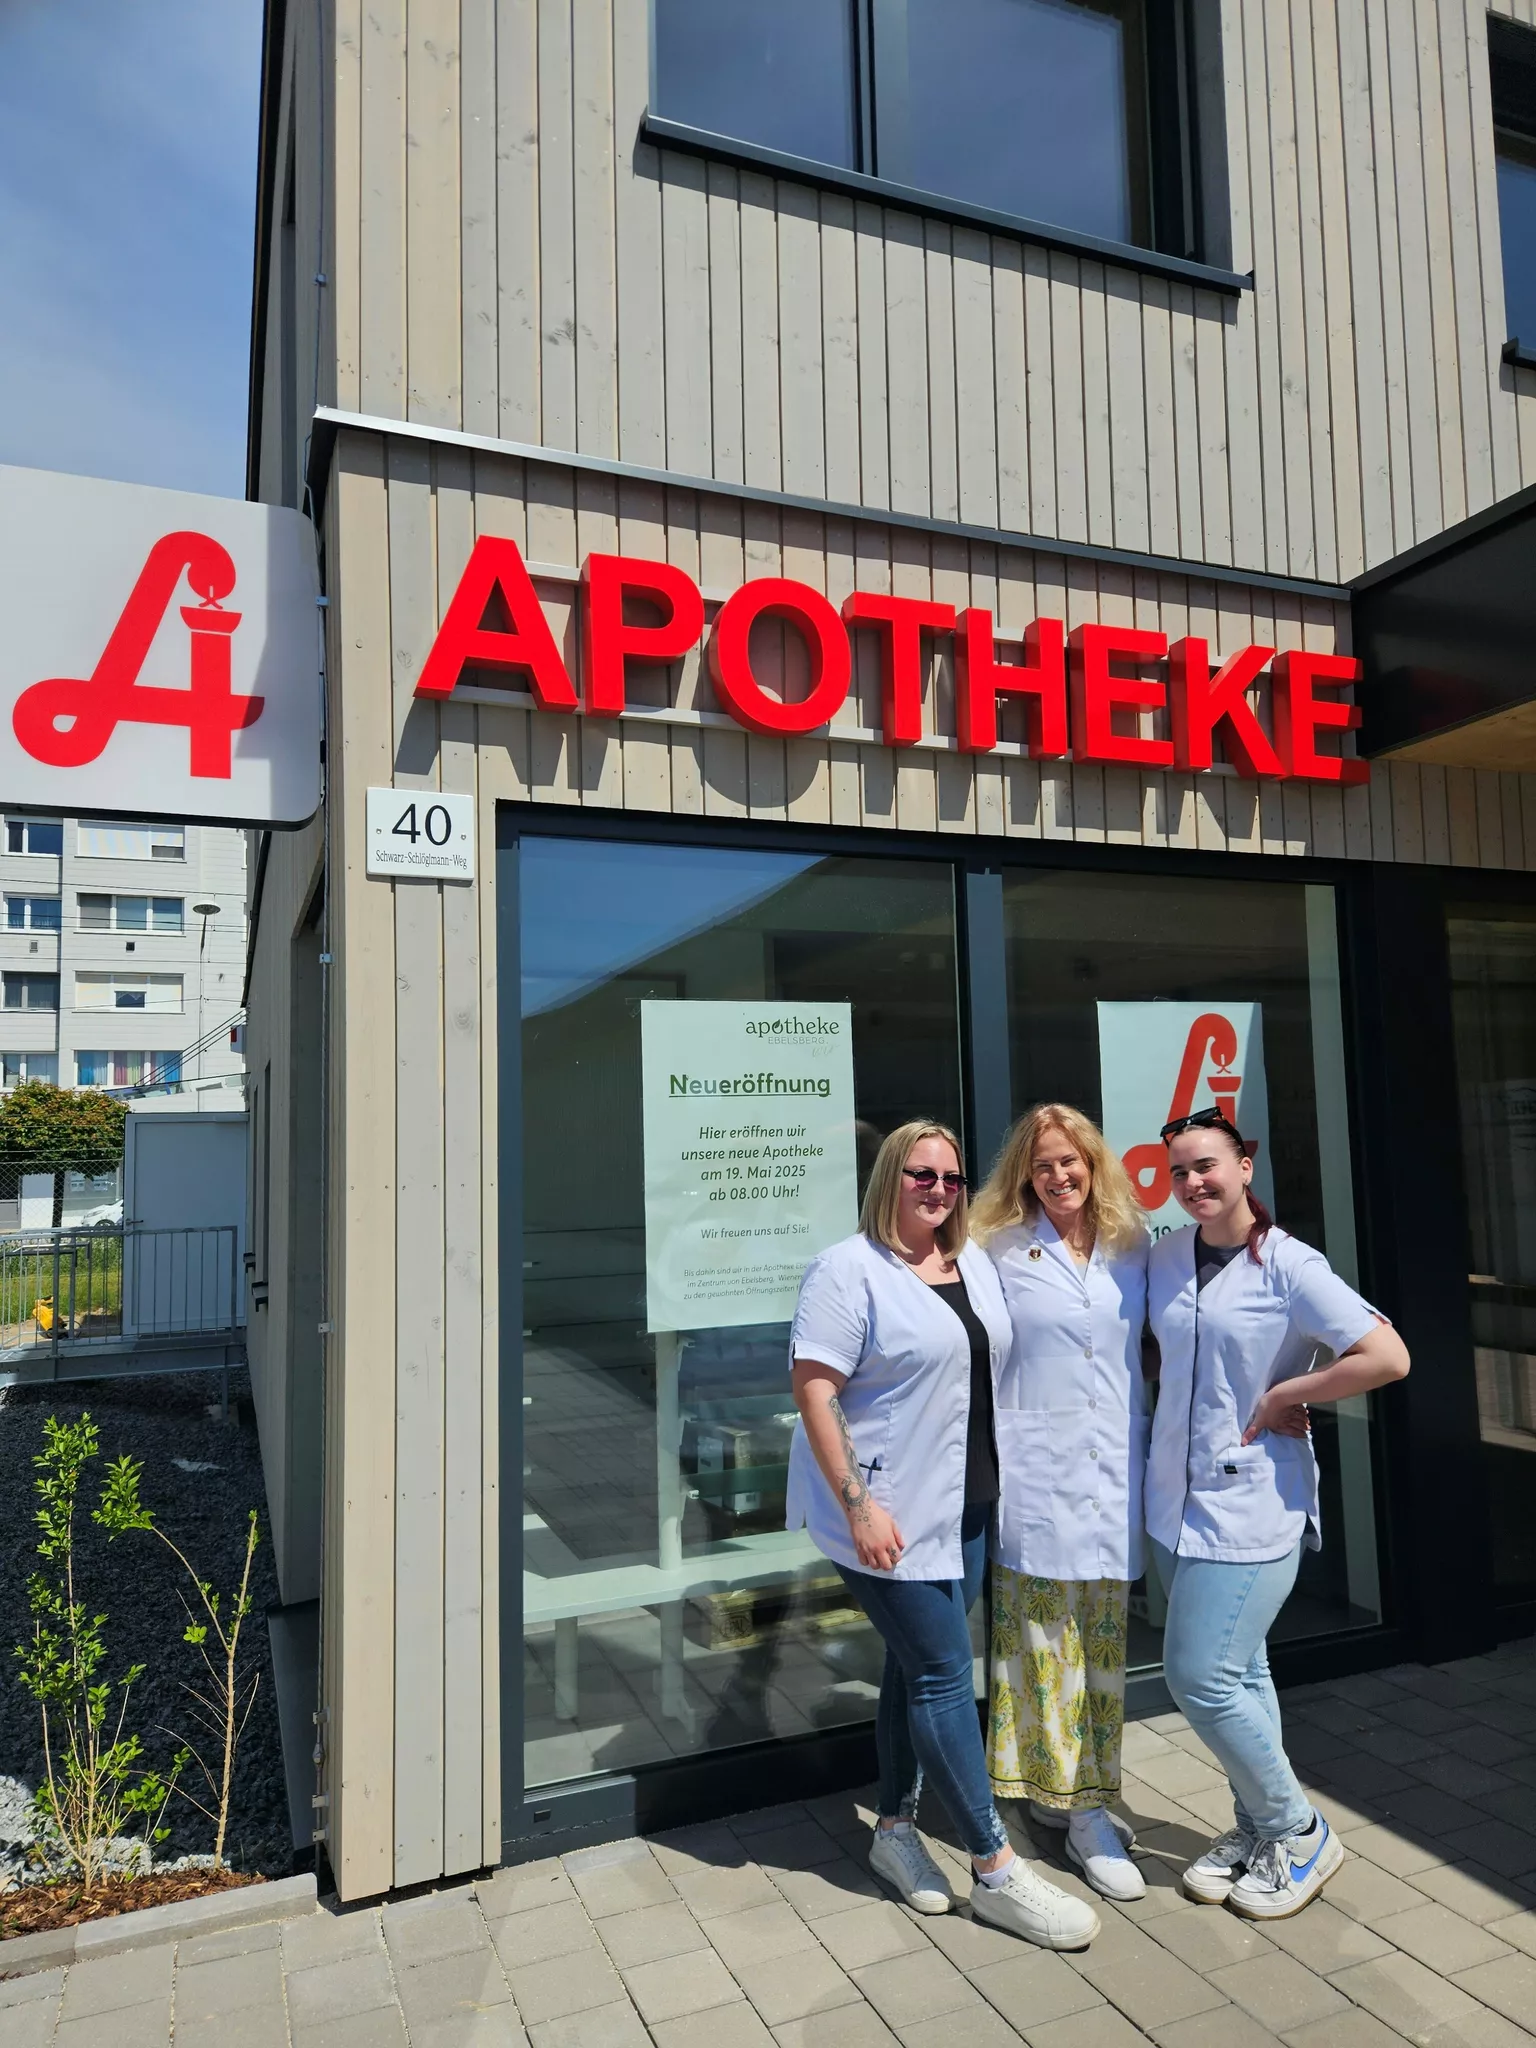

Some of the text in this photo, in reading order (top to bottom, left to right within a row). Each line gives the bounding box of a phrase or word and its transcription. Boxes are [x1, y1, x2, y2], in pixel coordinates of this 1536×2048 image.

[414, 535, 1371, 787] APOTHEKE
[391, 803, 452, 846] 40
[375, 849, 468, 870] Schwarz-Schlöglmann-Weg
[745, 1016, 840, 1038] apotheke
[669, 1072, 831, 1097] Neueröffnung
[700, 1124, 806, 1139] Hier eröffnen wir
[681, 1144, 824, 1161] unsere neue Apotheke
[700, 1164, 806, 1181] am 19. Mai 2025
[709, 1184, 799, 1201] ab 08.00 Uhr!
[701, 1222, 810, 1239] Wir freuen uns auf Sie!
[684, 1269, 695, 1277] Bis
[695, 1267, 716, 1276] dahin
[716, 1266, 731, 1275] sind
[731, 1265, 743, 1274] wir
[743, 1265, 751, 1273] in
[751, 1265, 762, 1273] der
[763, 1263, 795, 1272] Apotheke
[687, 1280, 697, 1288] im
[697, 1279, 727, 1288] Zentrum
[727, 1277, 741, 1286] von
[693, 1290, 706, 1299] den
[707, 1288, 745, 1300] gewohnten
